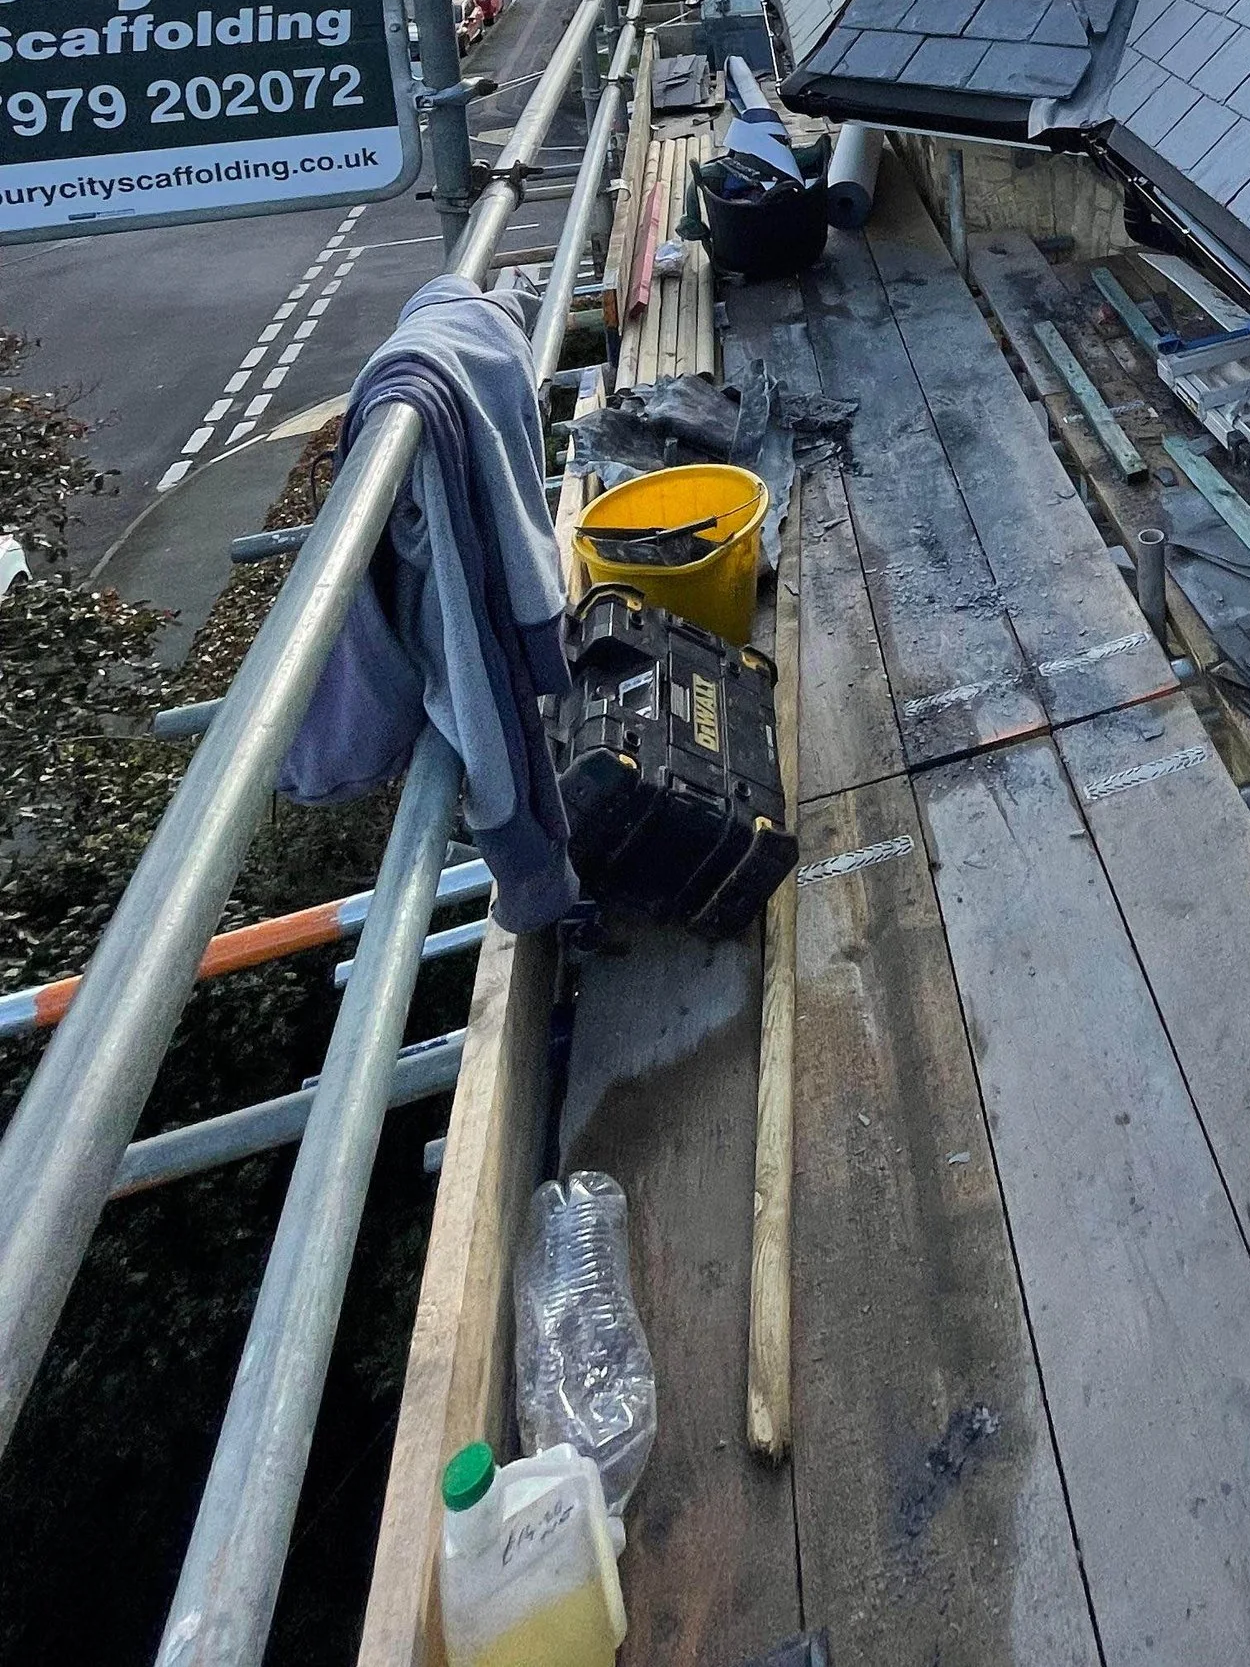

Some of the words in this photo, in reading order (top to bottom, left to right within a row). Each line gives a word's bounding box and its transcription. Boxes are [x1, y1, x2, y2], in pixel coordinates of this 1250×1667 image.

[0, 84, 127, 137] 979
[147, 64, 364, 124] 202072
[0, 147, 379, 208] urycityscaffolding.co.uk
